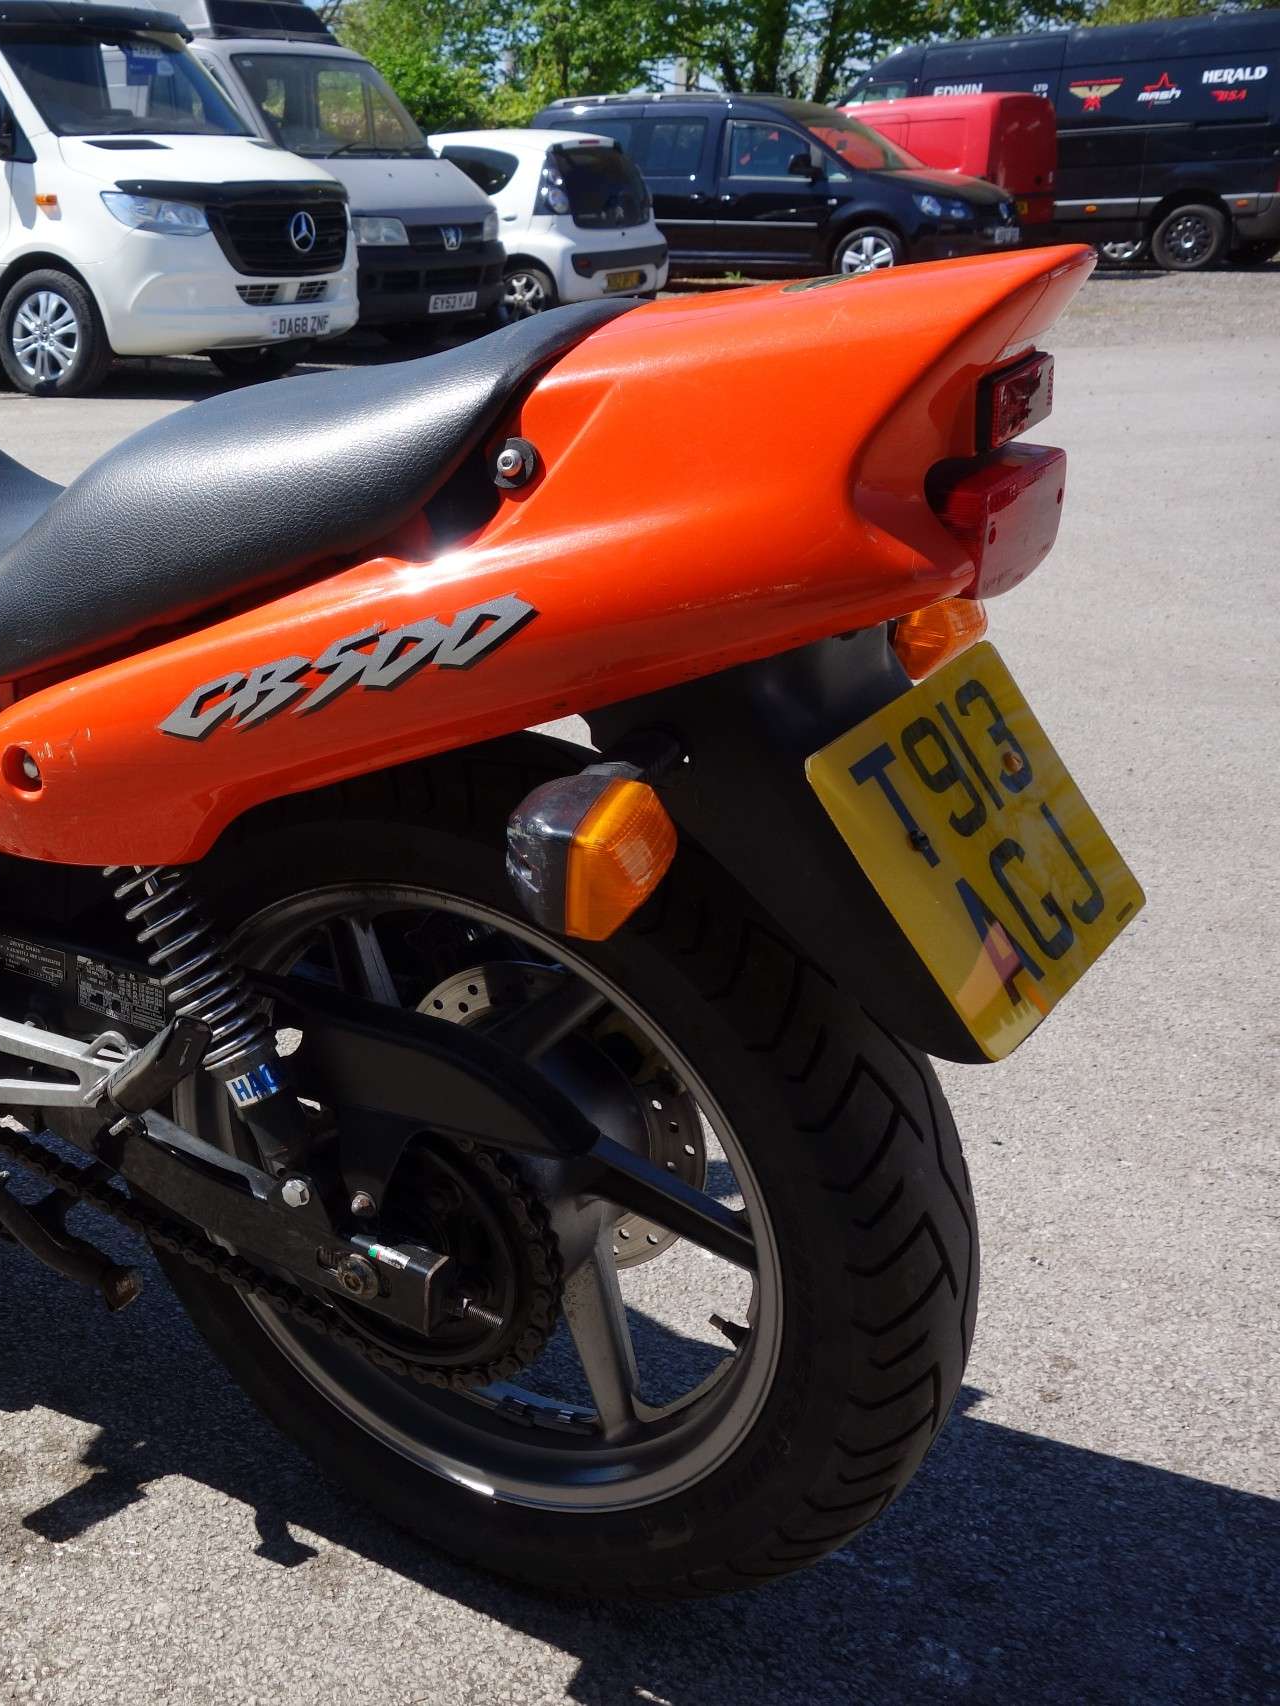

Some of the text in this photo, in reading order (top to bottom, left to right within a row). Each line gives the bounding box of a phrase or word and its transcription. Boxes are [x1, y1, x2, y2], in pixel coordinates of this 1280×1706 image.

[1202, 66, 1269, 84] HERALD
[933, 83, 984, 97] EDWIN
[433, 295, 457, 310] EY53
[278, 314, 329, 335] DA68 ZNF
[849, 678, 1035, 869] T913
[954, 802, 1107, 1007] AGJ
